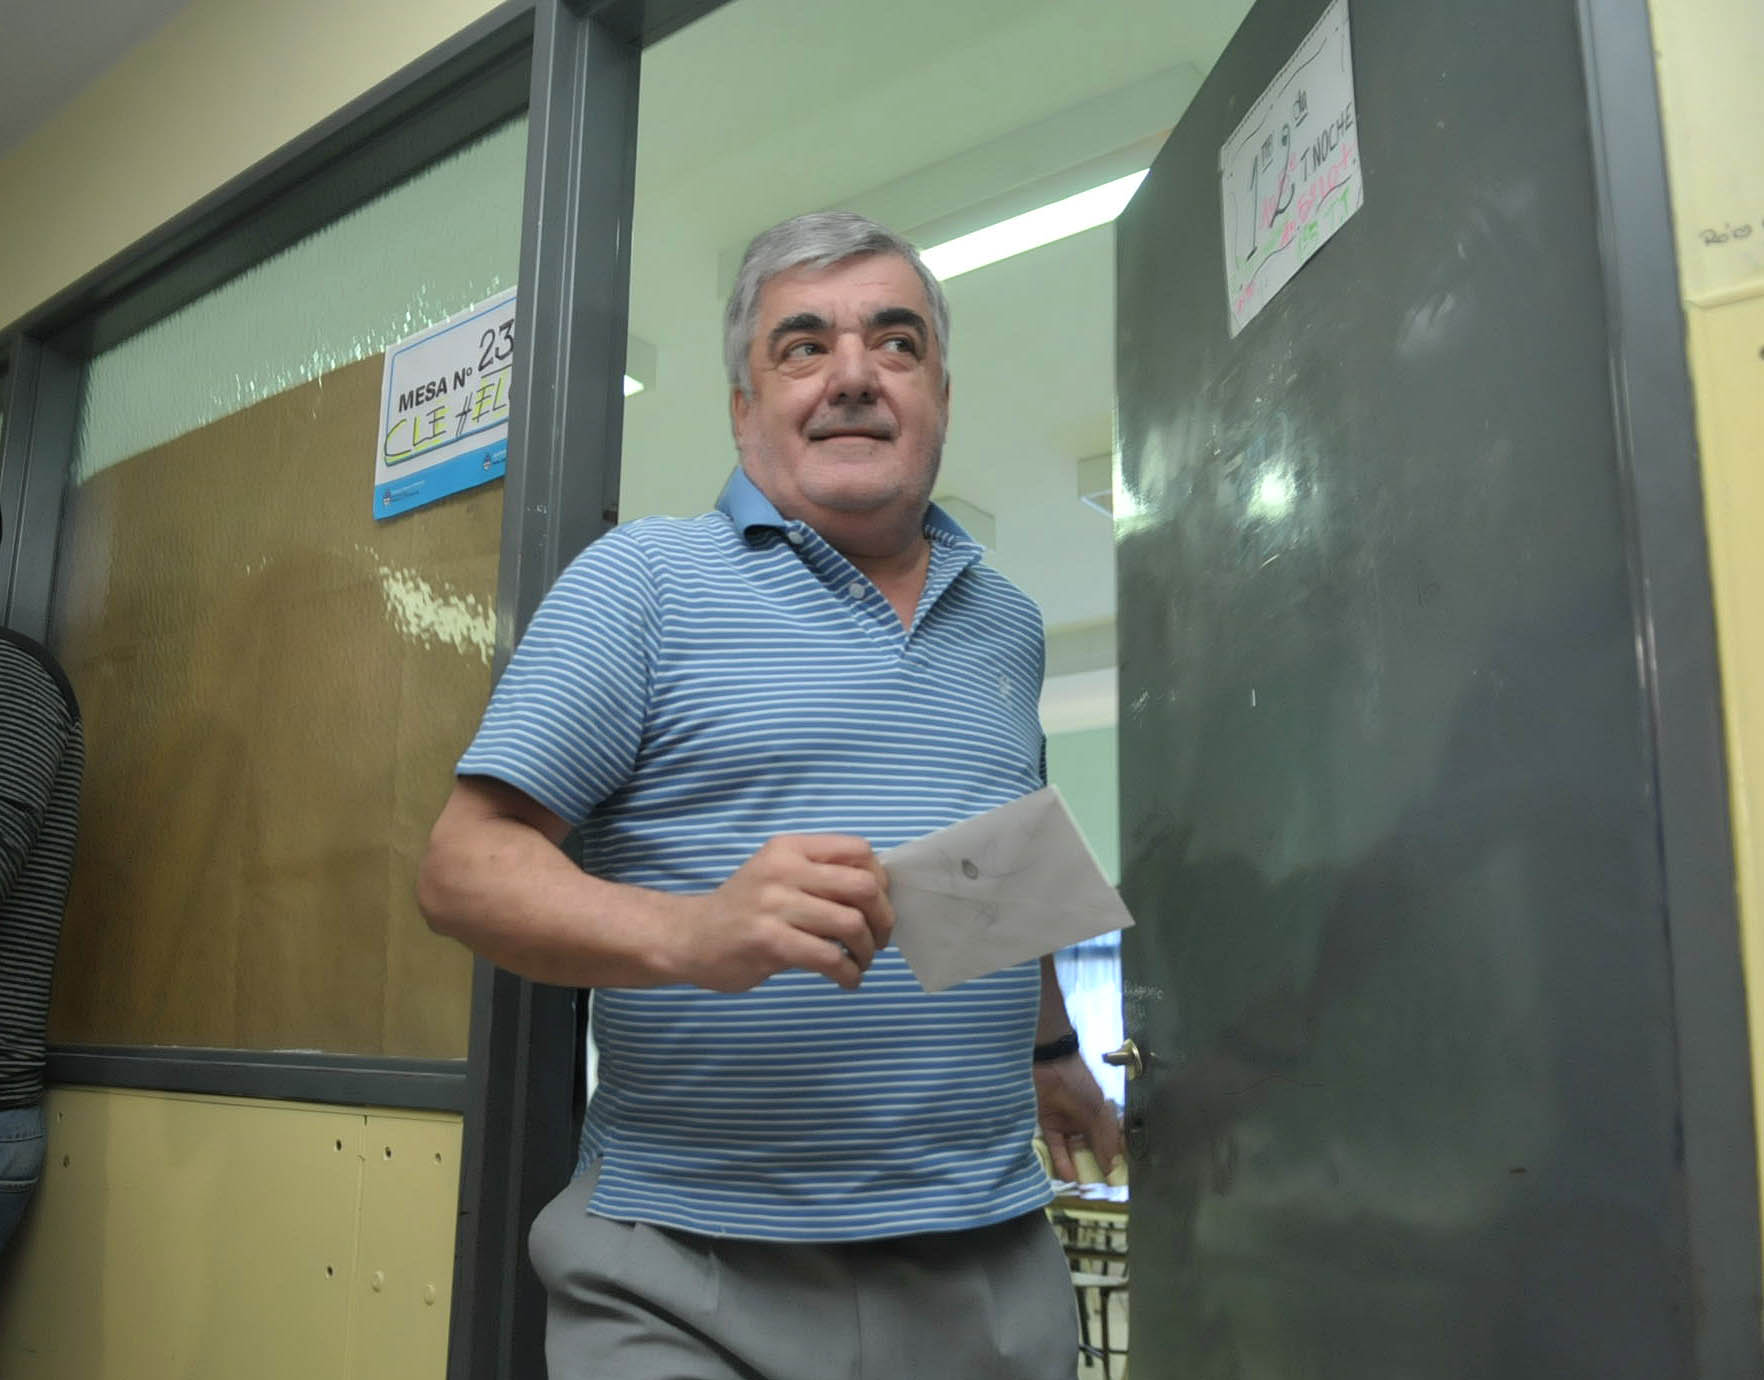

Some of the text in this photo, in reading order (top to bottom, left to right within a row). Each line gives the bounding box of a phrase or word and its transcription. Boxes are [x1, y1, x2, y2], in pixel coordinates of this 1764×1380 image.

[1312, 102, 1354, 172] NOCHE
[398, 376, 449, 413] MESA
[455, 377, 512, 437] HEL
